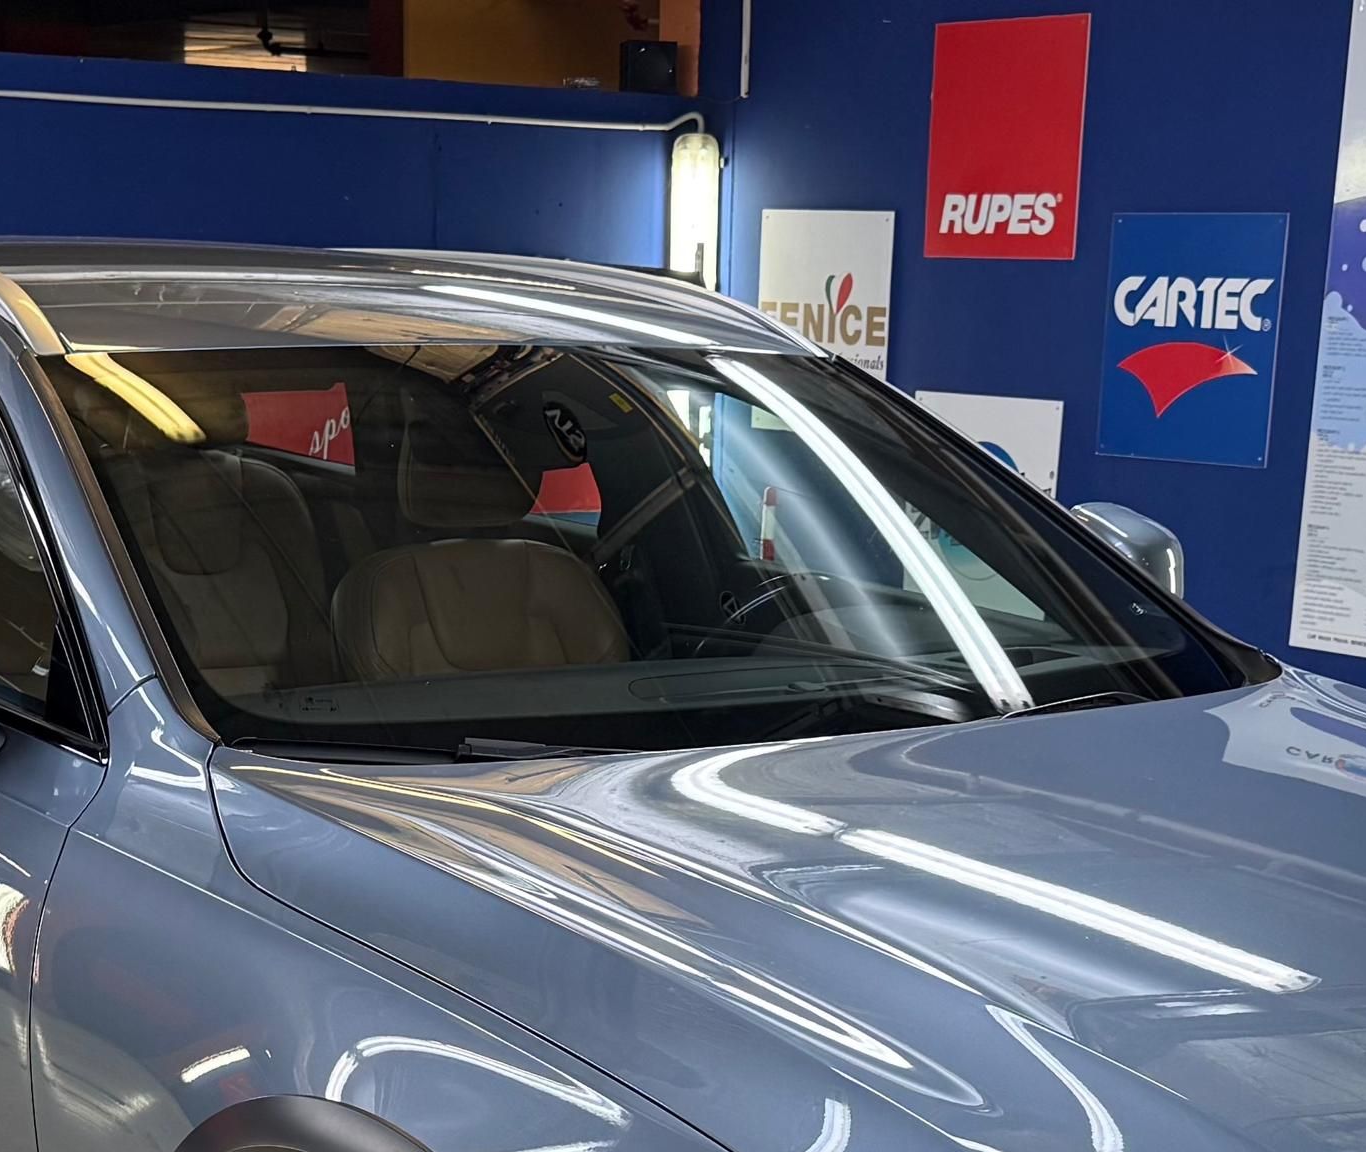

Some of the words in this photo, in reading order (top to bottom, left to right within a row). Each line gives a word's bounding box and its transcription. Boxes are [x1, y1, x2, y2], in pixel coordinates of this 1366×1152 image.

[938, 193, 1056, 236] RUPES
[1113, 275, 1275, 332] CARTEC
[308, 405, 351, 460] spo
